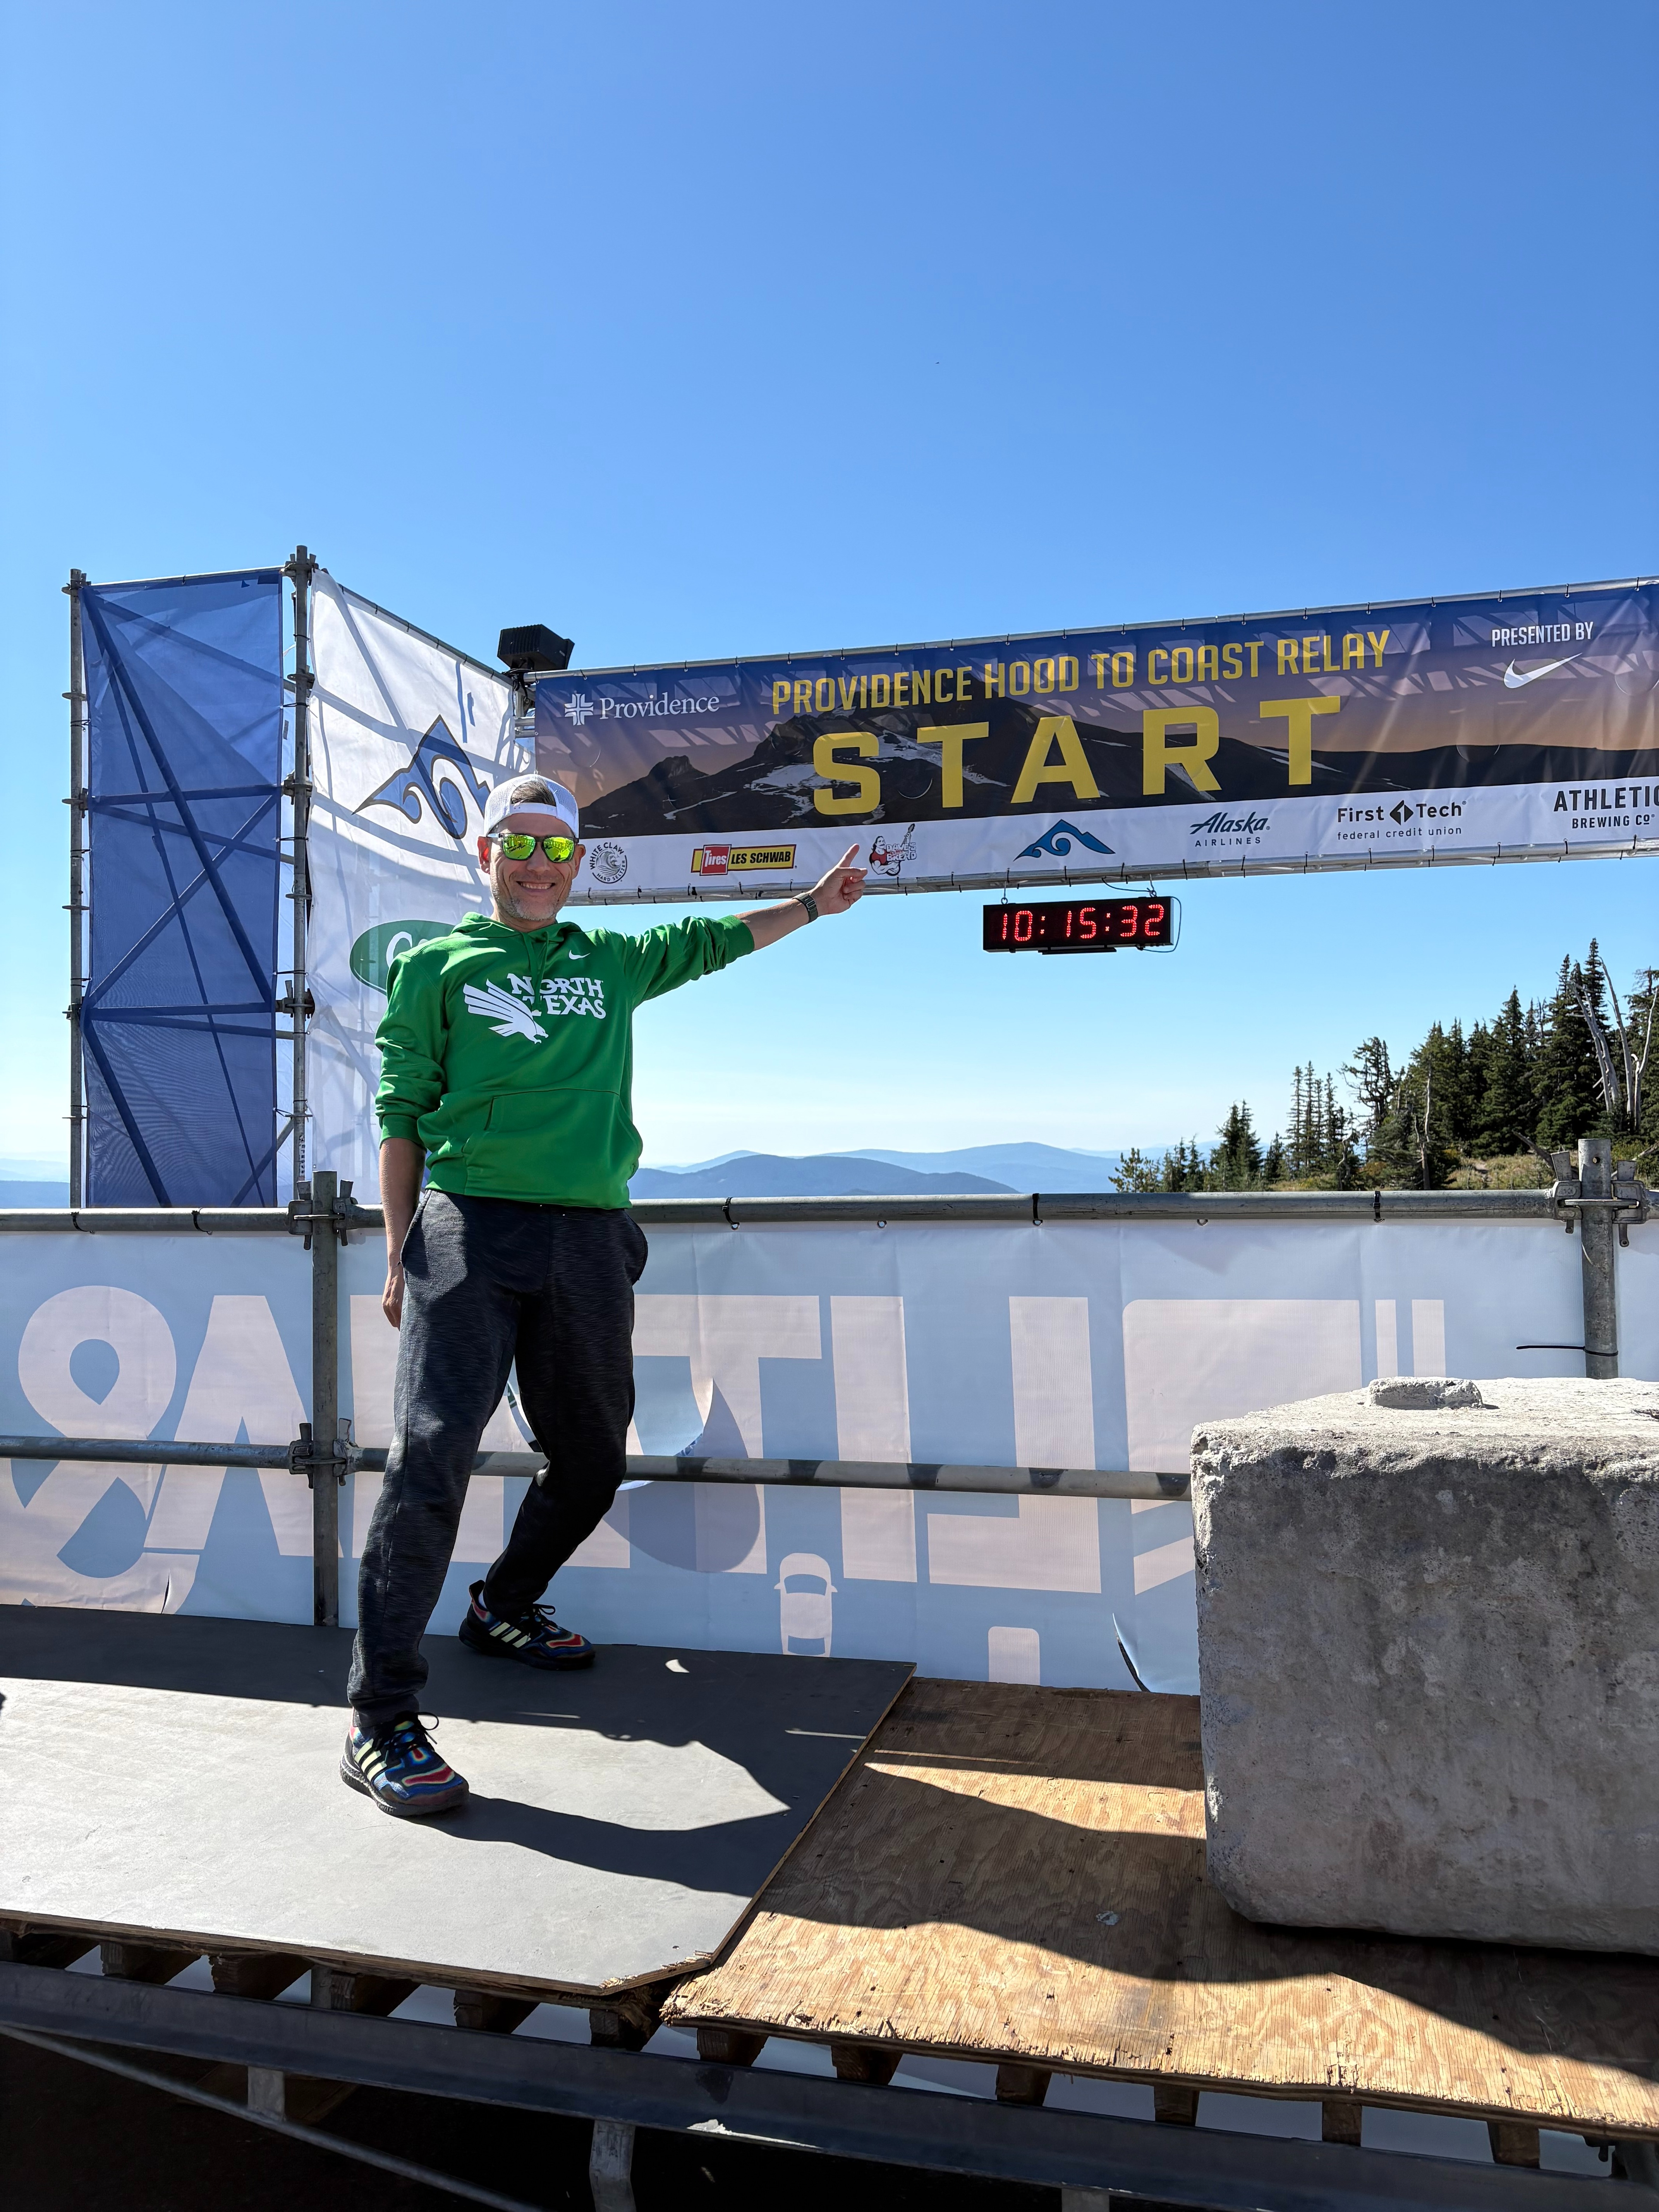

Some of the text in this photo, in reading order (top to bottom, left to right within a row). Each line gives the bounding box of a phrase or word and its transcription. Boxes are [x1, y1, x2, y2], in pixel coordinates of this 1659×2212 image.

[1492, 621, 1594, 647] PRESENTED BY
[772, 630, 1389, 714] PROVIDENCE HOOD TO COAST RELAY
[599, 692, 720, 720] Providence
[813, 696, 1340, 815] START
[1189, 811, 1268, 835] Alaska
[1338, 802, 1462, 823] First Tech
[1572, 815, 1630, 829] BREWING
[1195, 836, 1261, 847] AIRLINES
[1337, 826, 1462, 840] federal credit union
[589, 842, 624, 870] WHITE CLAW
[886, 842, 916, 852] DAVE'S
[886, 852, 917, 862] BREAD
[704, 850, 791, 867] Tires LES SCHWAB
[596, 873, 611, 882] HARD
[1002, 904, 1164, 941] 10:15:32
[507, 973, 604, 999] NORTH
